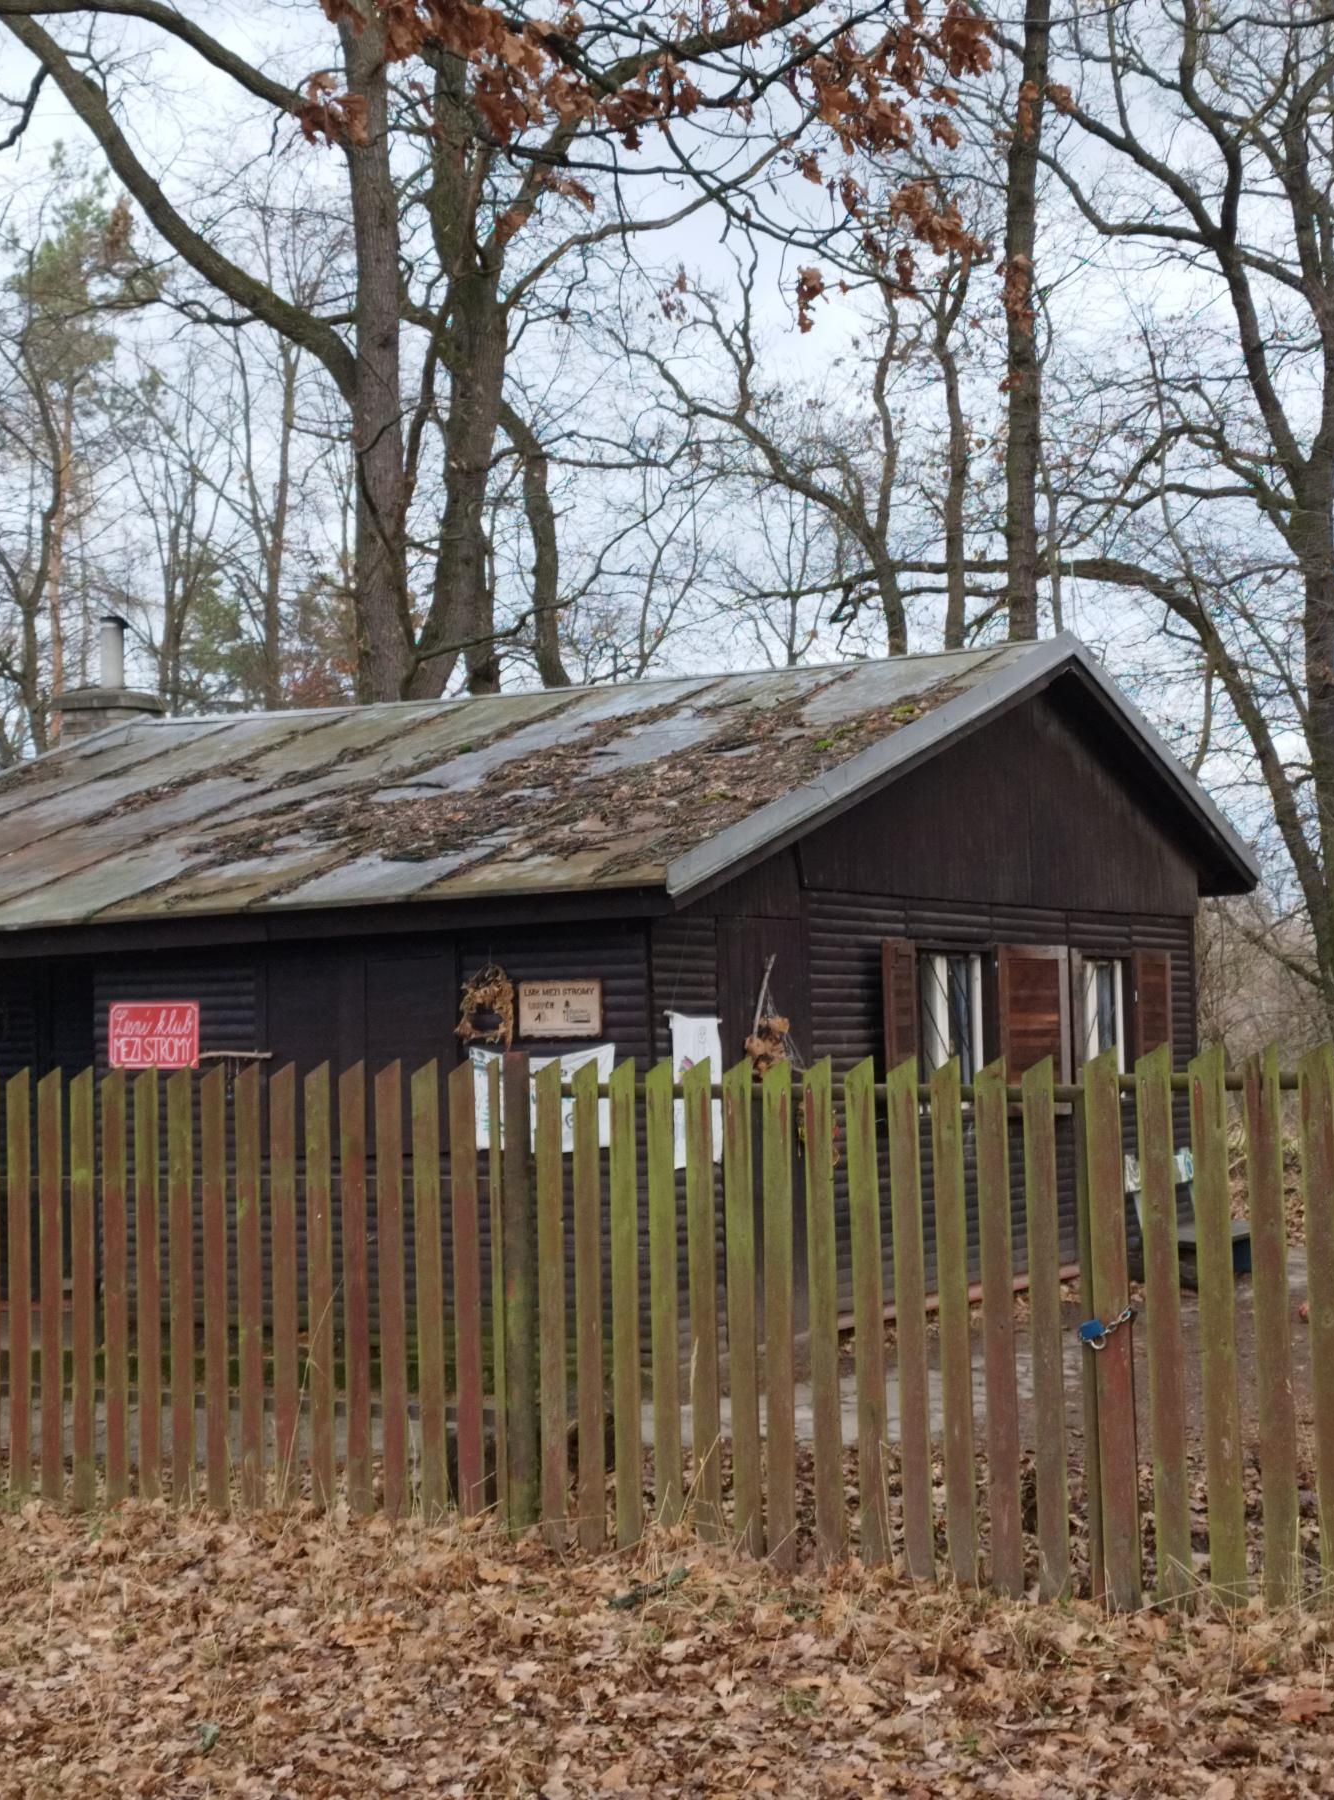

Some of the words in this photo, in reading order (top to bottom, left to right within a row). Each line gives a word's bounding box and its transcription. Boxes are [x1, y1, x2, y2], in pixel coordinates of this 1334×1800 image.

[563, 987, 595, 996] STROMY
[153, 1009, 192, 1035] klub
[113, 1037, 142, 1062] MEZI
[143, 1037, 193, 1062] STROMY
